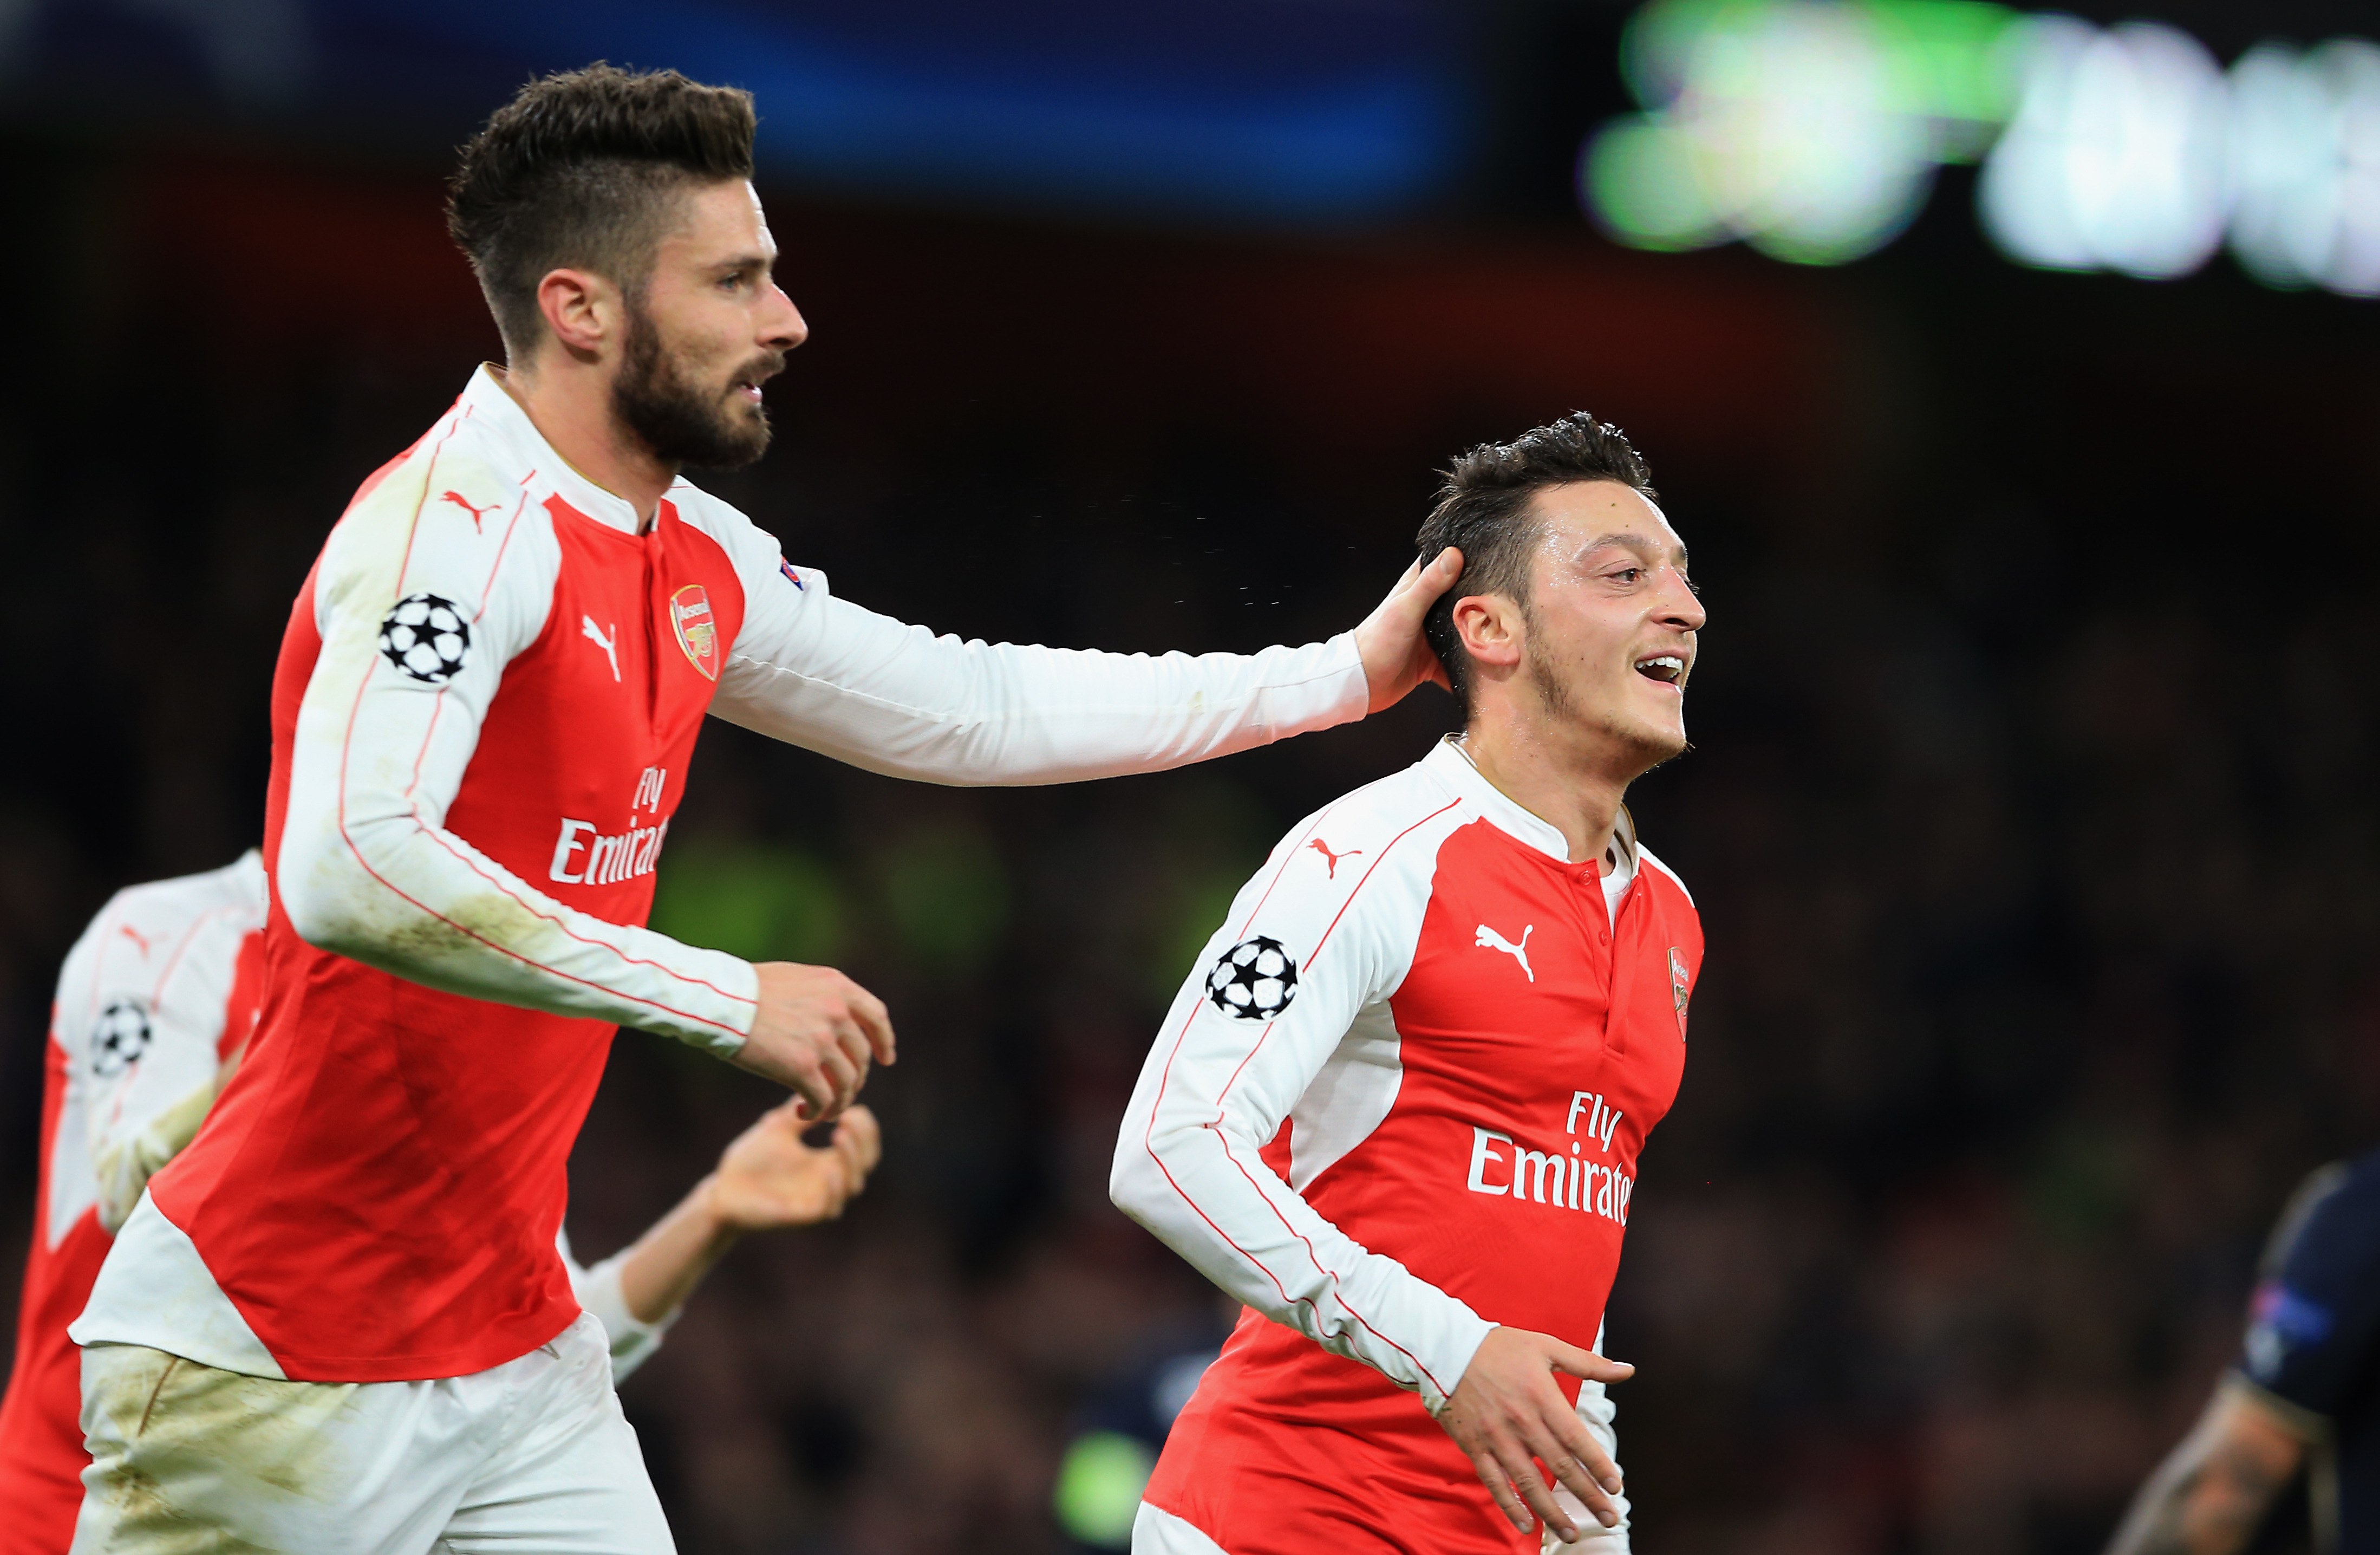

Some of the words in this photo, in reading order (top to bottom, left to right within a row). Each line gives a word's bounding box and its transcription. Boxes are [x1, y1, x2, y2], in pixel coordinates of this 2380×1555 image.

[631, 765, 667, 814] Fly
[549, 815, 669, 885] Emirat
[1567, 1090, 1623, 1153] Fly
[1468, 1126, 1634, 1227] Emirate
